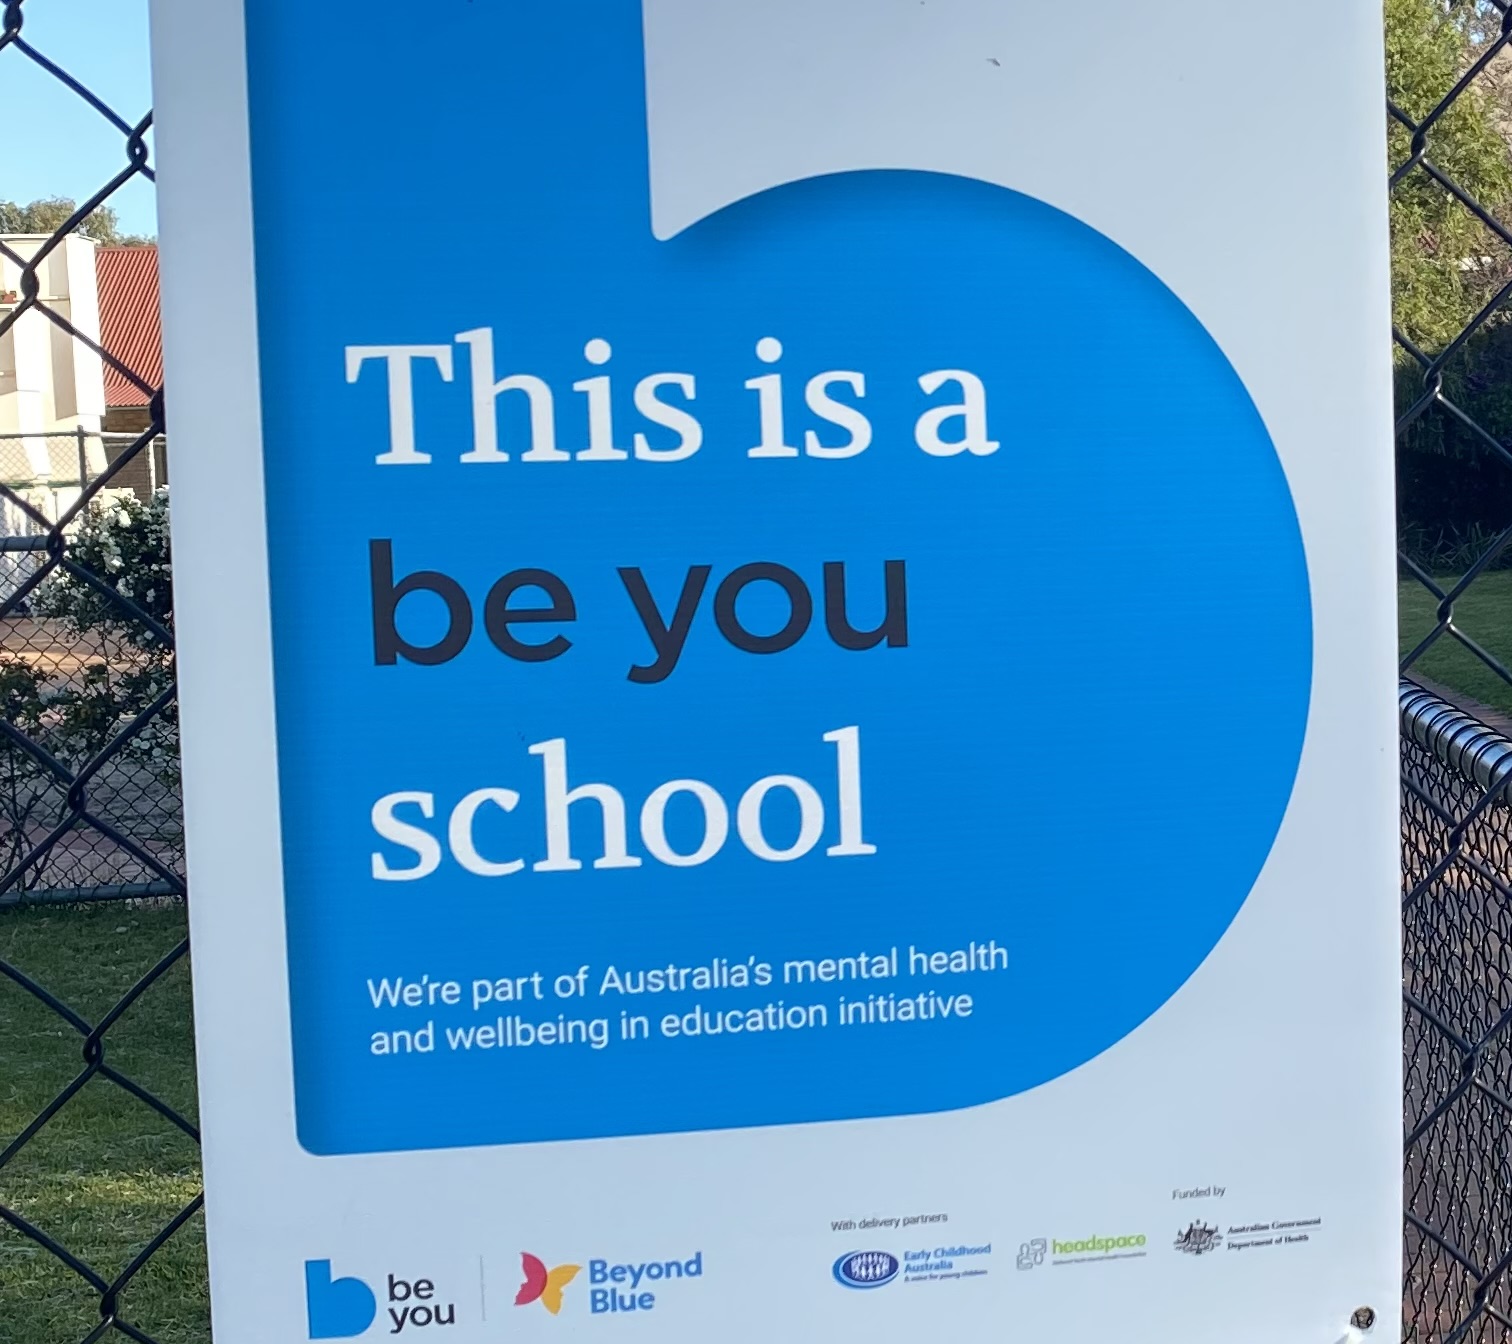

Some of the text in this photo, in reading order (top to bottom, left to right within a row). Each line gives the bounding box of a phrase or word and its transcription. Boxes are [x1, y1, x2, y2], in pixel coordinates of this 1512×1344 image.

[345, 327, 999, 465] This is a
[369, 538, 909, 684] be you
[370, 726, 877, 882] school
[366, 940, 1009, 1010] We're part of Australia's mental health
[370, 990, 974, 1055] and wellbeing in education initiative
[1172, 1184, 1226, 1200] Funded by
[831, 1212, 948, 1232] With delivery partners
[904, 1241, 992, 1262] Early Childhood
[1052, 1234, 1147, 1254] headspace
[589, 1252, 703, 1290] Beyond
[904, 1259, 953, 1274] Australia
[387, 1274, 435, 1303] be
[590, 1288, 656, 1315] Blue
[388, 1301, 456, 1334] you
